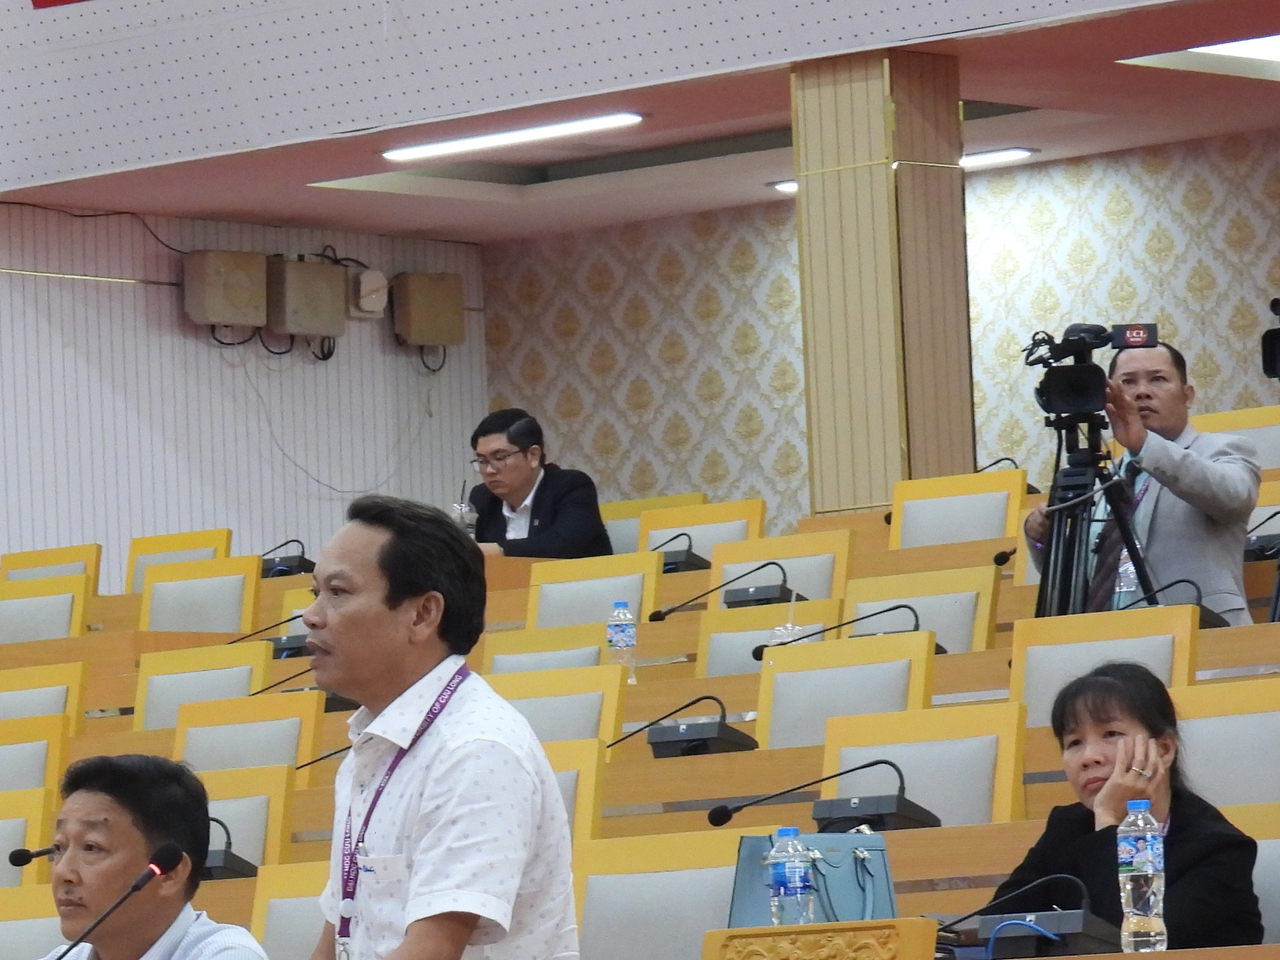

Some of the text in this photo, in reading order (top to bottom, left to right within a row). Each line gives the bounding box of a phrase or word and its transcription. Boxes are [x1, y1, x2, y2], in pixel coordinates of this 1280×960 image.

[1126, 330, 1147, 338] UCL
[431, 700, 443, 714] OF
[448, 674, 464, 691] LONG
